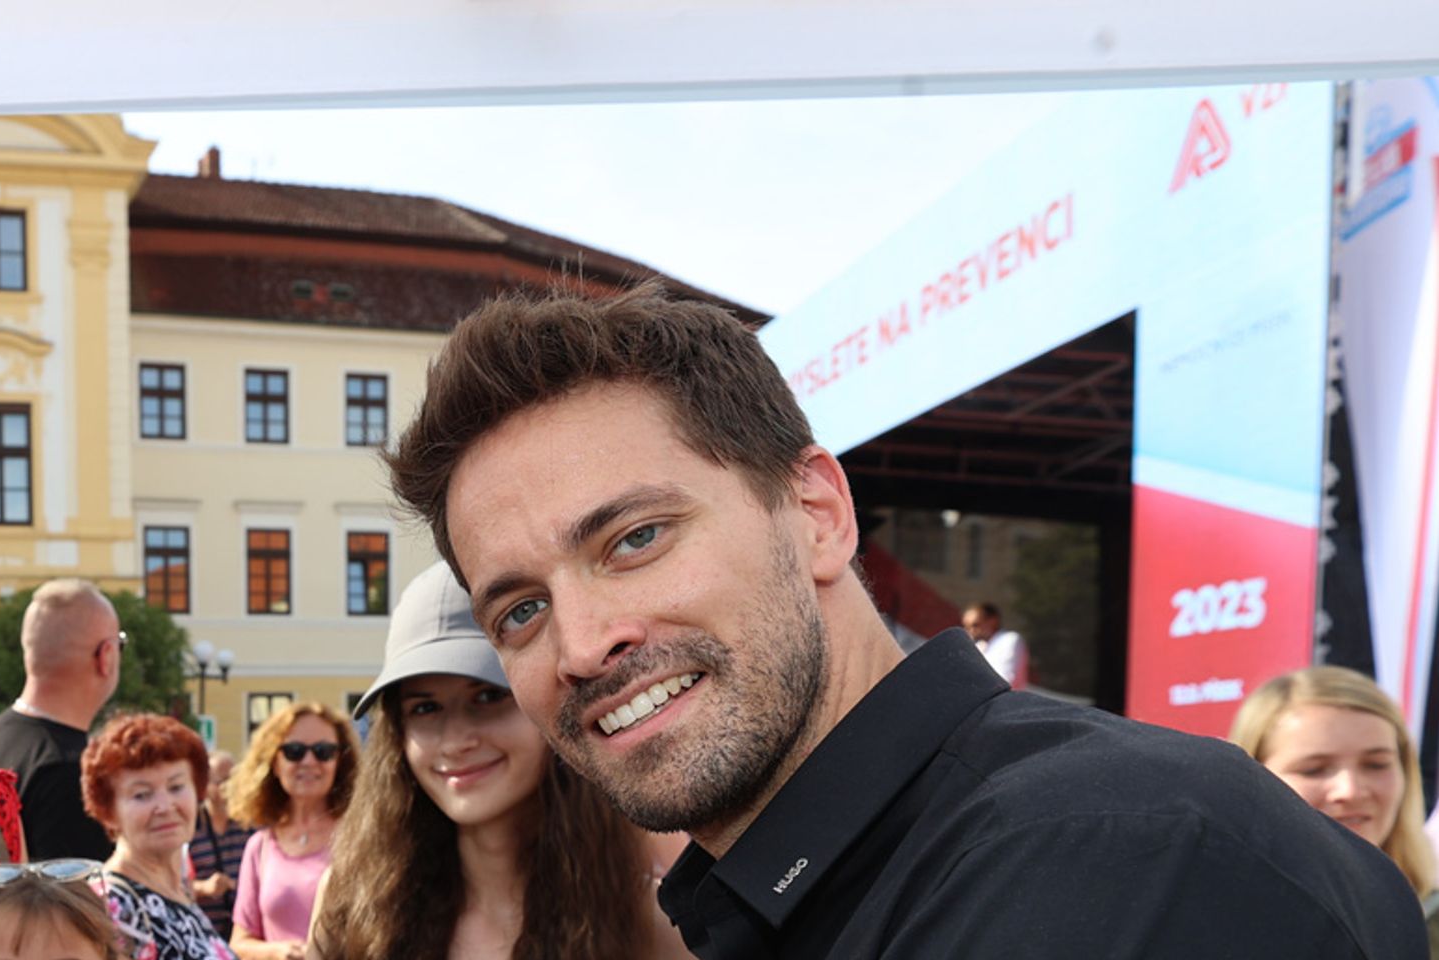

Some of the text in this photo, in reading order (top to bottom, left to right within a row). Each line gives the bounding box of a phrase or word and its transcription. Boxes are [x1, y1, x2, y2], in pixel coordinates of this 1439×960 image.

[877, 299, 913, 350] NA
[920, 190, 1074, 326] PREVENCI
[1168, 575, 1268, 638] 2023
